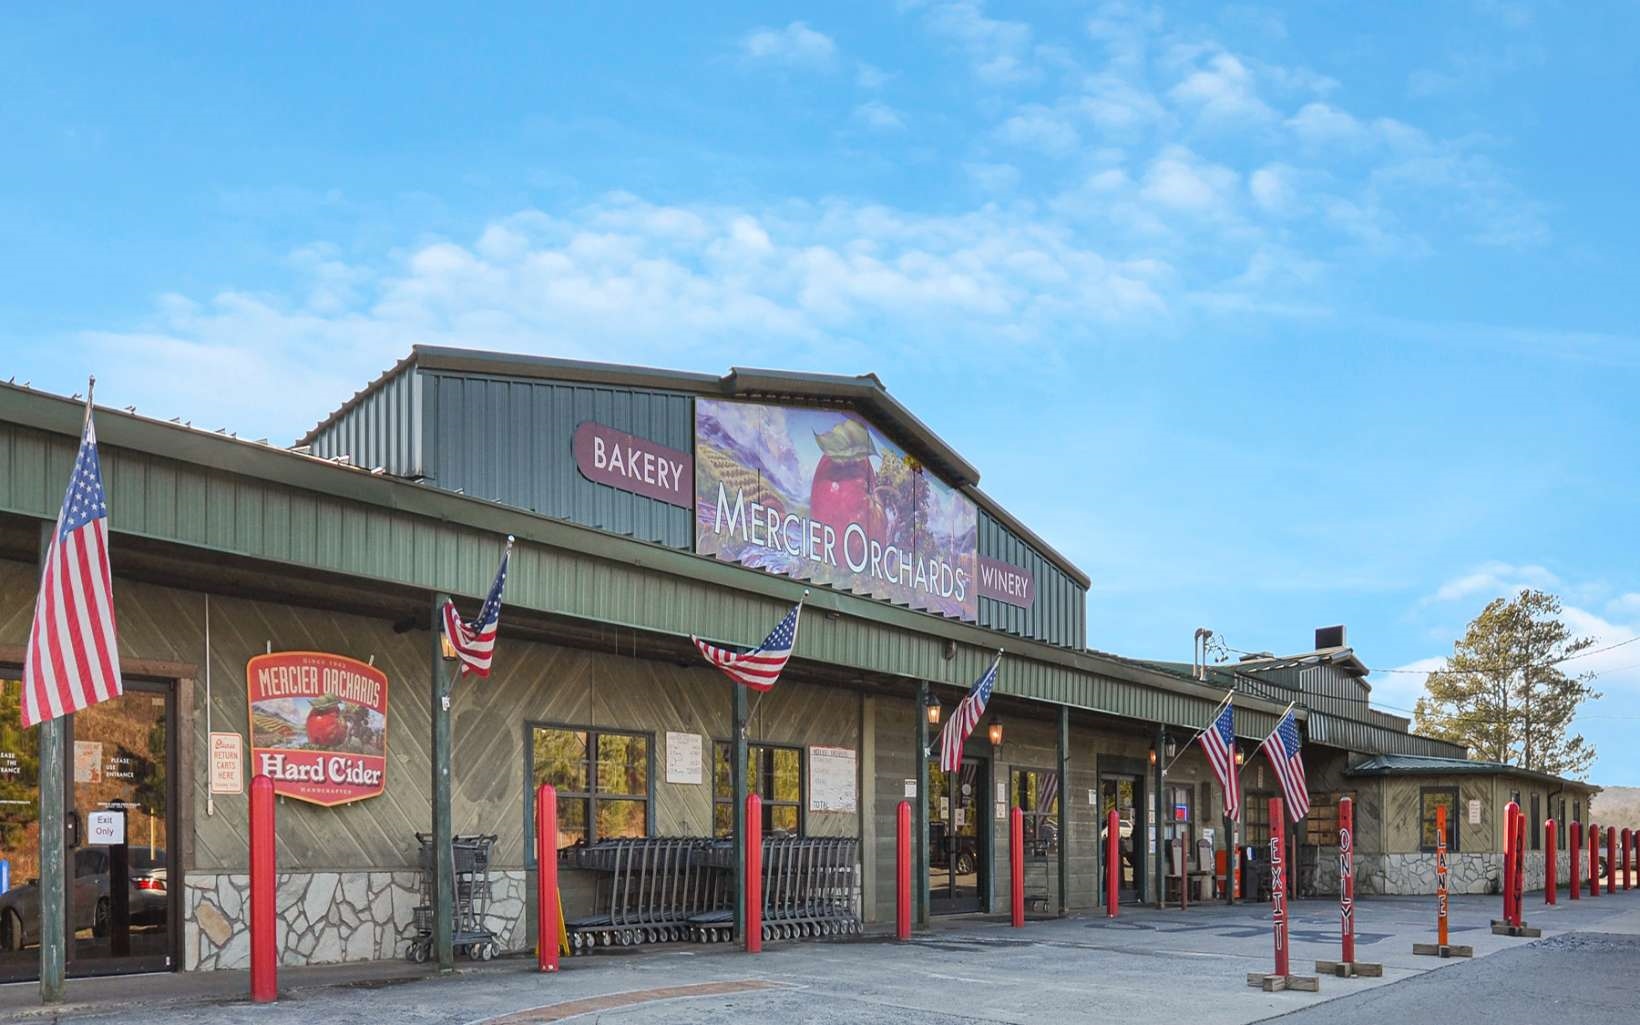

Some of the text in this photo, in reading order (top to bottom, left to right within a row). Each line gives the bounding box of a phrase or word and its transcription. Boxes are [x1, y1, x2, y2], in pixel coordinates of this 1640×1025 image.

[594, 436, 684, 492] BAKERY
[714, 480, 966, 602] MERCIER ORCHARDS
[981, 563, 1028, 598] WINERY
[258, 666, 381, 708] MERCIER ORCHARDS
[214, 751, 238, 760] RETURN
[217, 760, 236, 769] CARTS
[260, 753, 382, 786] Hard Cider
[218, 771, 235, 780] HERE
[96, 827, 114, 836] Only
[97, 816, 113, 824] Exit
[1339, 828, 1351, 936] ONLY
[1437, 829, 1448, 917] LANE
[1270, 838, 1284, 950] EXIT
